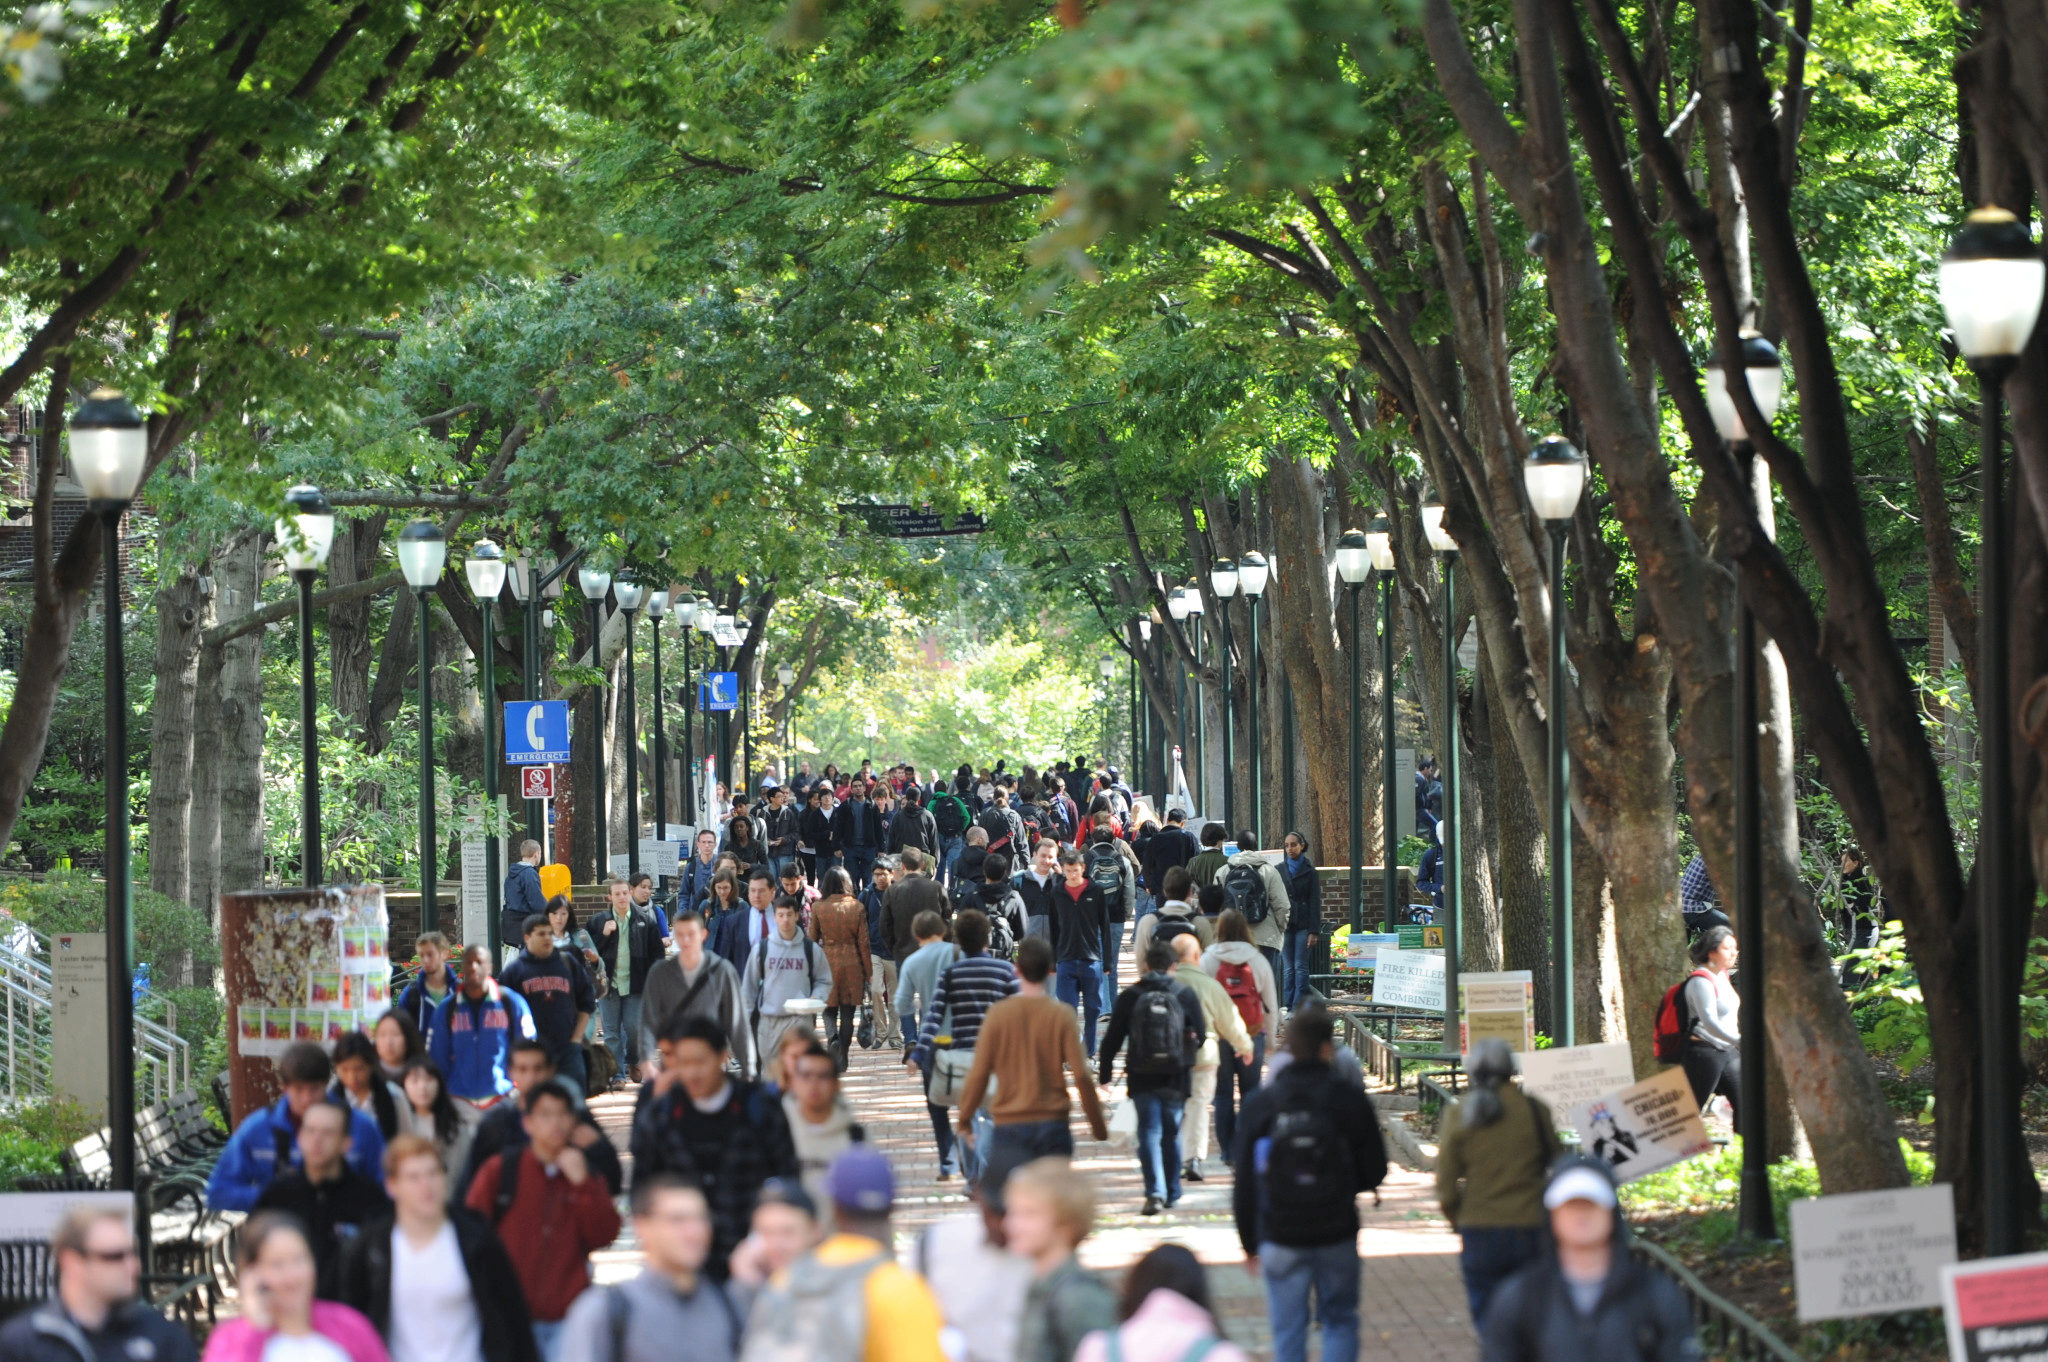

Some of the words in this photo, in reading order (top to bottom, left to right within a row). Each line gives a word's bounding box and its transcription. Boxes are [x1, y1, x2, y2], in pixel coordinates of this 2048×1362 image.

[510, 752, 564, 761] EMERGENCY
[768, 957, 804, 971] PENN
[1382, 963, 1406, 973] FIRE
[1408, 967, 1446, 979] KILLED
[1382, 991, 1441, 1007] COMBINED
[1841, 1266, 1914, 1289] SMOKE
